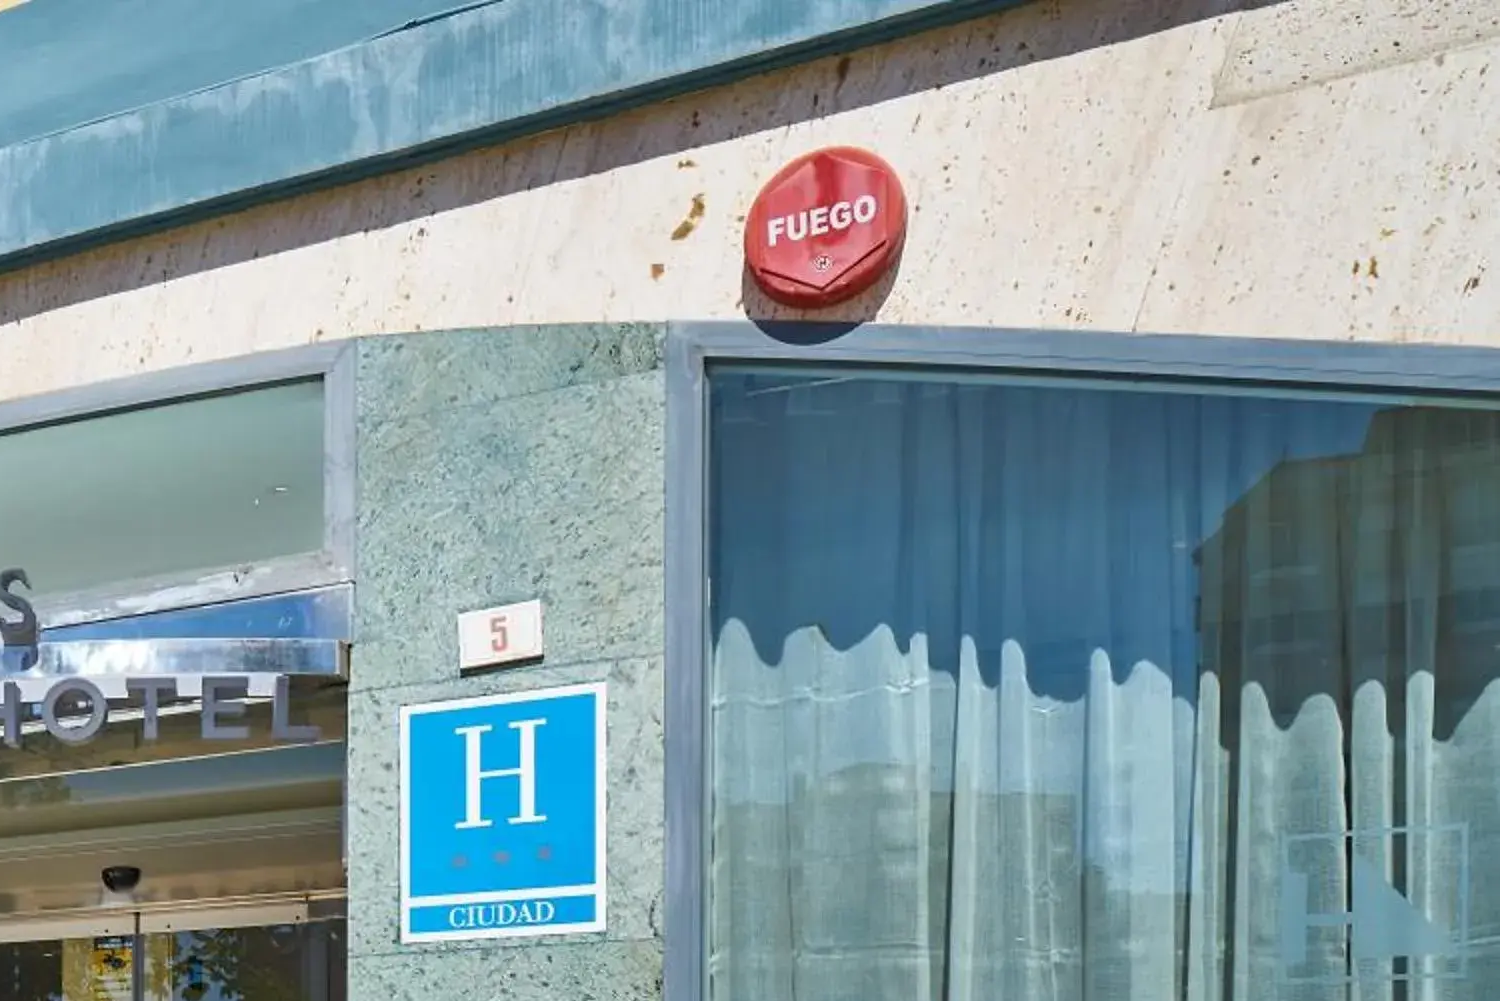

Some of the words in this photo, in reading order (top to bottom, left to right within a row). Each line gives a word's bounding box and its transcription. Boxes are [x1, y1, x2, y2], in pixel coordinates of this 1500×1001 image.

[767, 195, 877, 247] FUEGO
[490, 615, 508, 652] 5
[454, 718, 547, 829] H
[449, 901, 555, 928] CIUDAD
